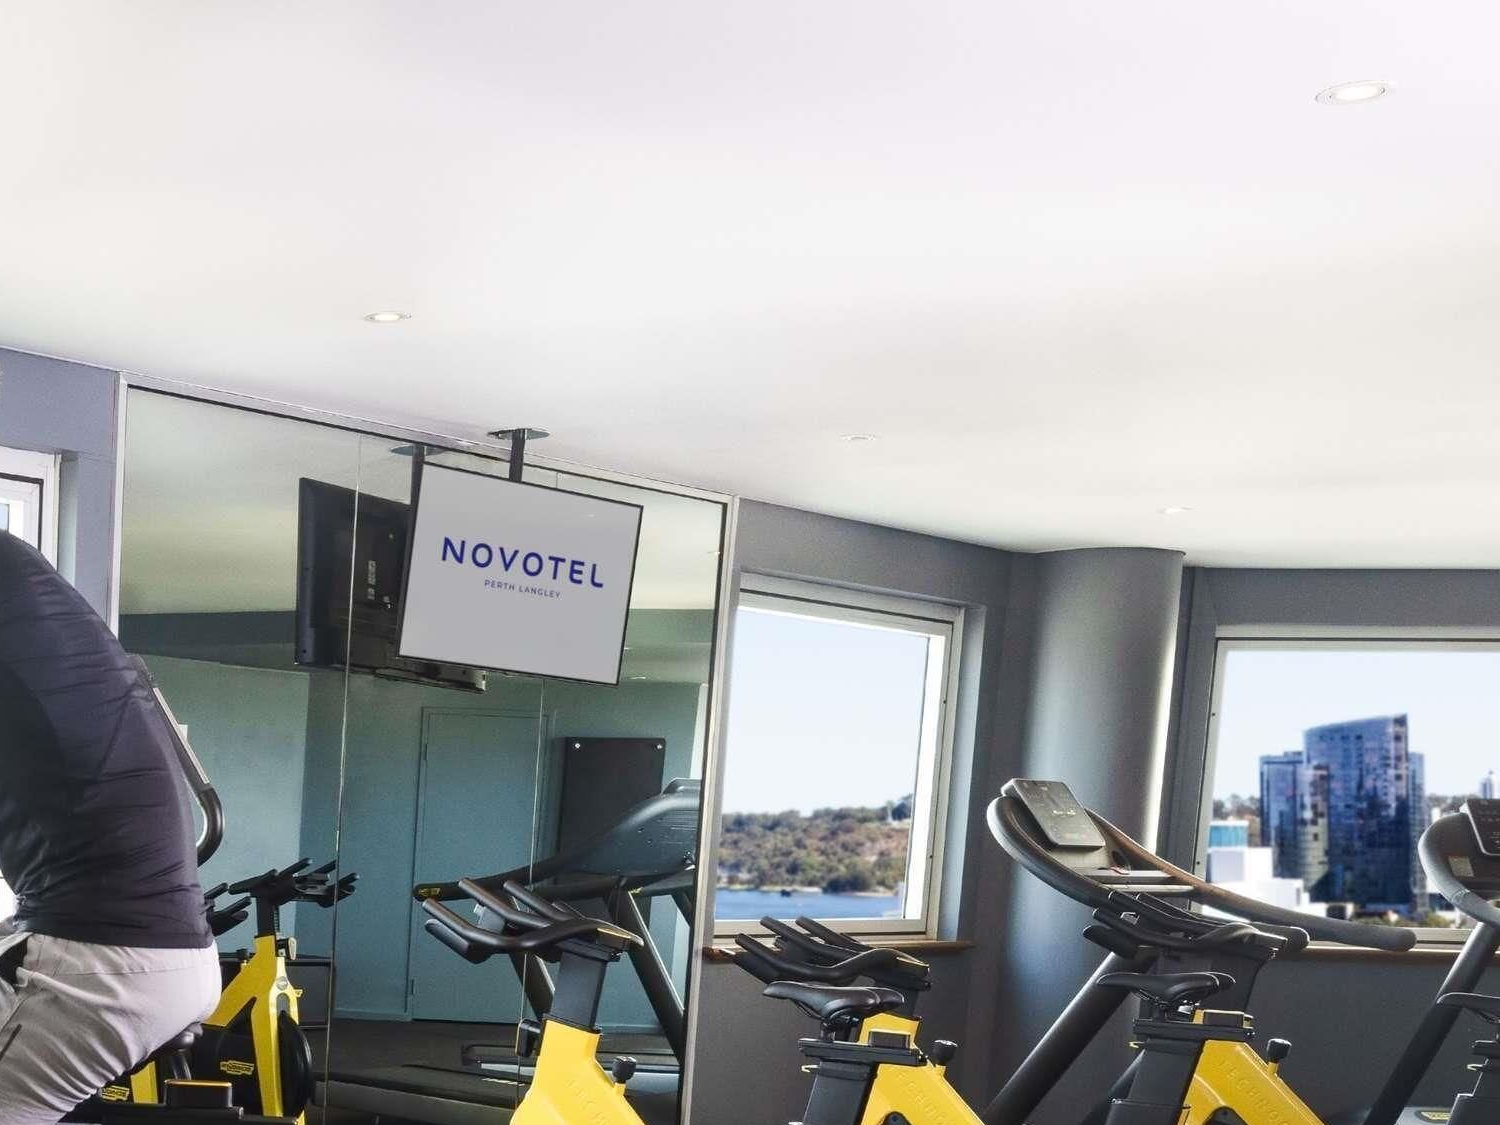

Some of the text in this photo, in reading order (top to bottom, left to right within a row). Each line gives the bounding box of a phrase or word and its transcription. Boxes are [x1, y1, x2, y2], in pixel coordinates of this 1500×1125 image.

[441, 536, 604, 588] NOVOTEL
[484, 579, 561, 598] PERTH LANGLEY
